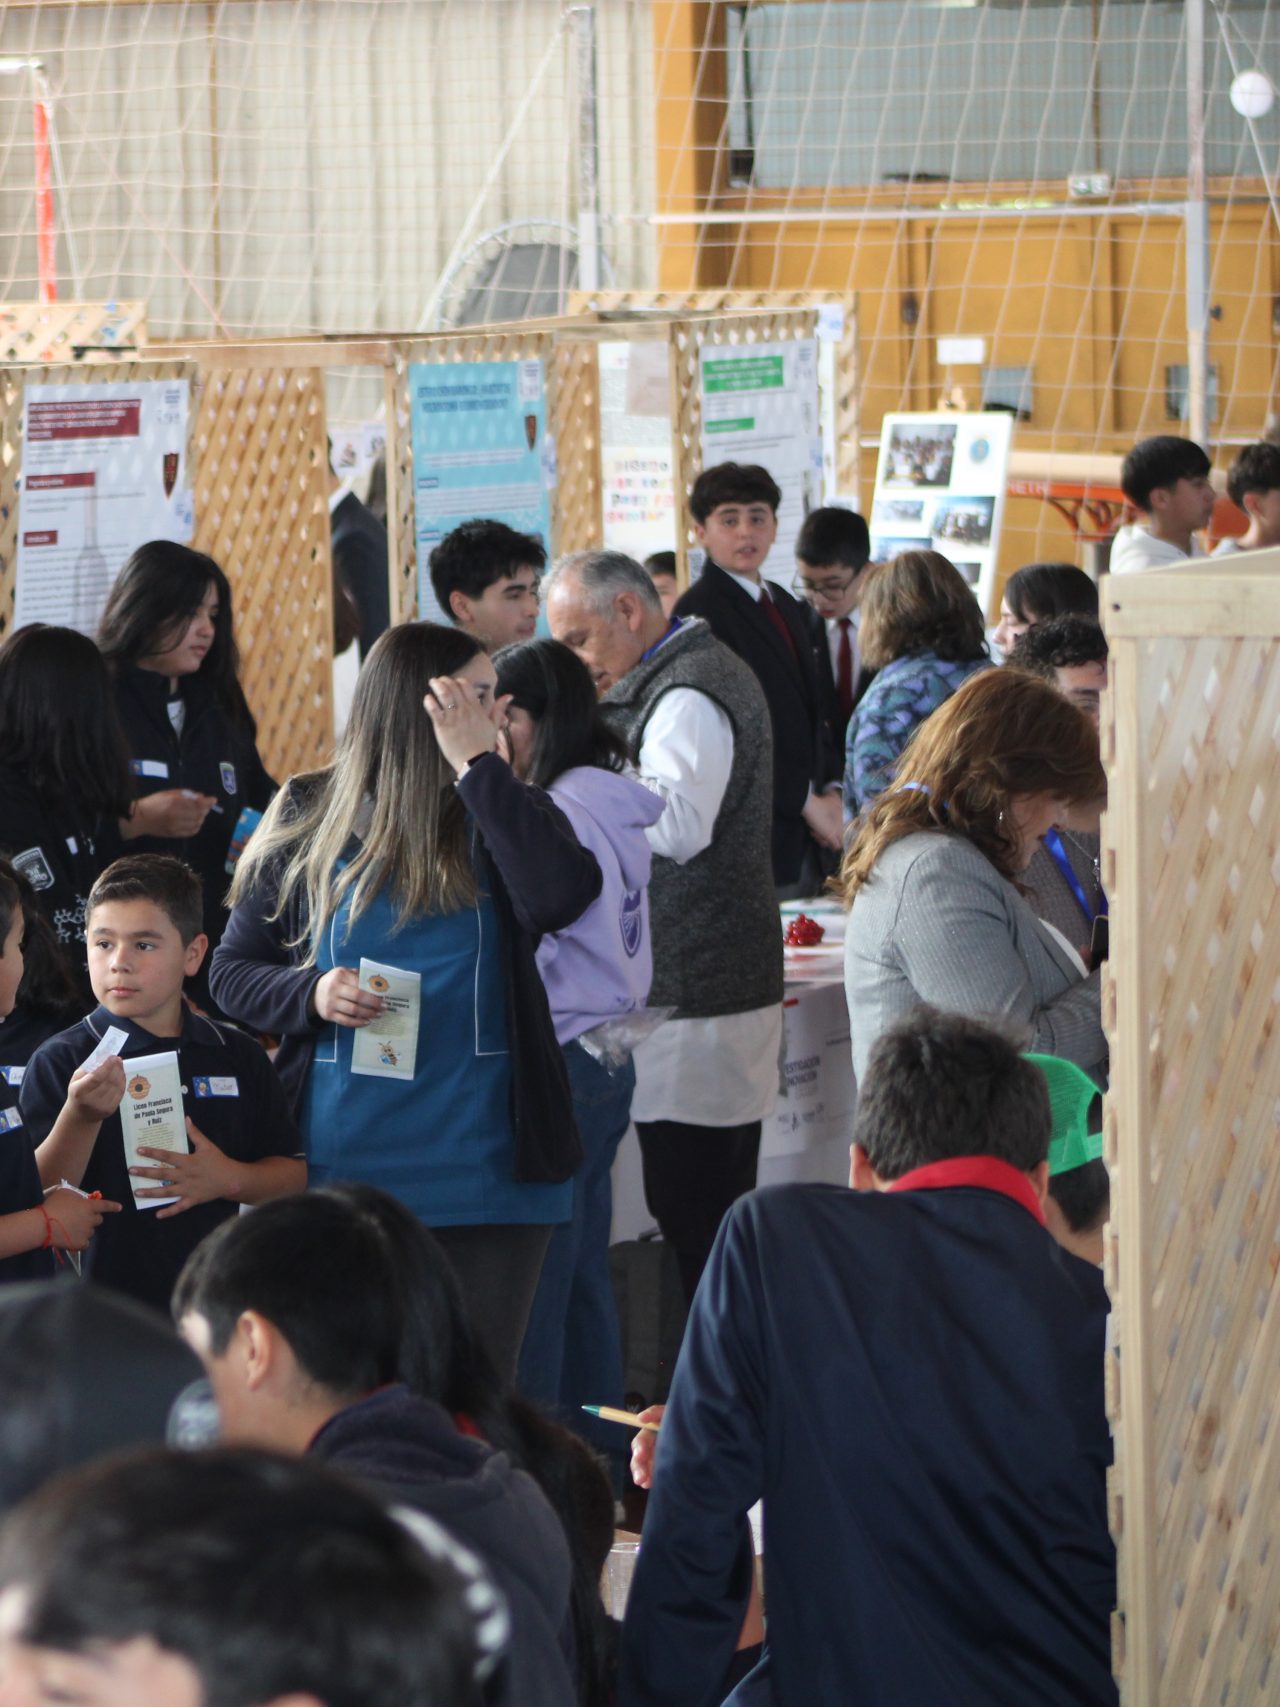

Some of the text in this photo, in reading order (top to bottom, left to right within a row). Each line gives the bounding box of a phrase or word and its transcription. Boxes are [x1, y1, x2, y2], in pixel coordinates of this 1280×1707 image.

[133, 1097, 172, 1111] Liceo Francisca
[134, 1106, 174, 1120] de Paula Segura
